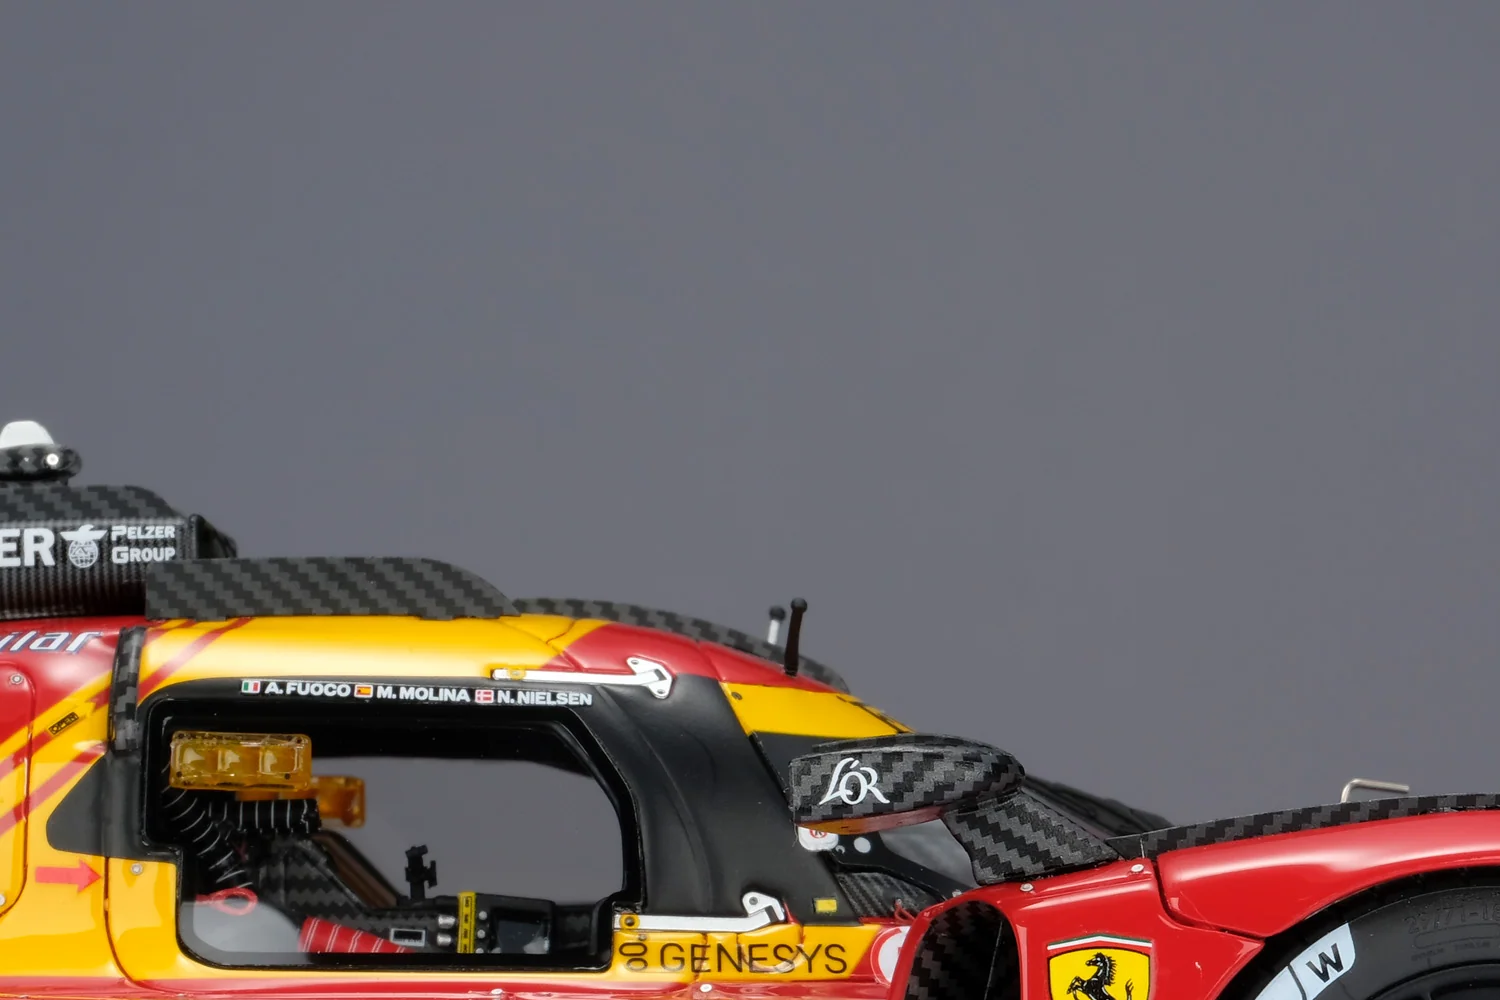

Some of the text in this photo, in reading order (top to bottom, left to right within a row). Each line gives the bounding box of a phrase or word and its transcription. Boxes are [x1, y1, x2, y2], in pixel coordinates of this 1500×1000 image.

[264, 682, 351, 698] A. FUOCO
[376, 685, 471, 703] M. MOLINA
[497, 690, 593, 706] N. NIELSEN
[660, 942, 848, 974] GENESYS
[1306, 943, 1343, 983] W
